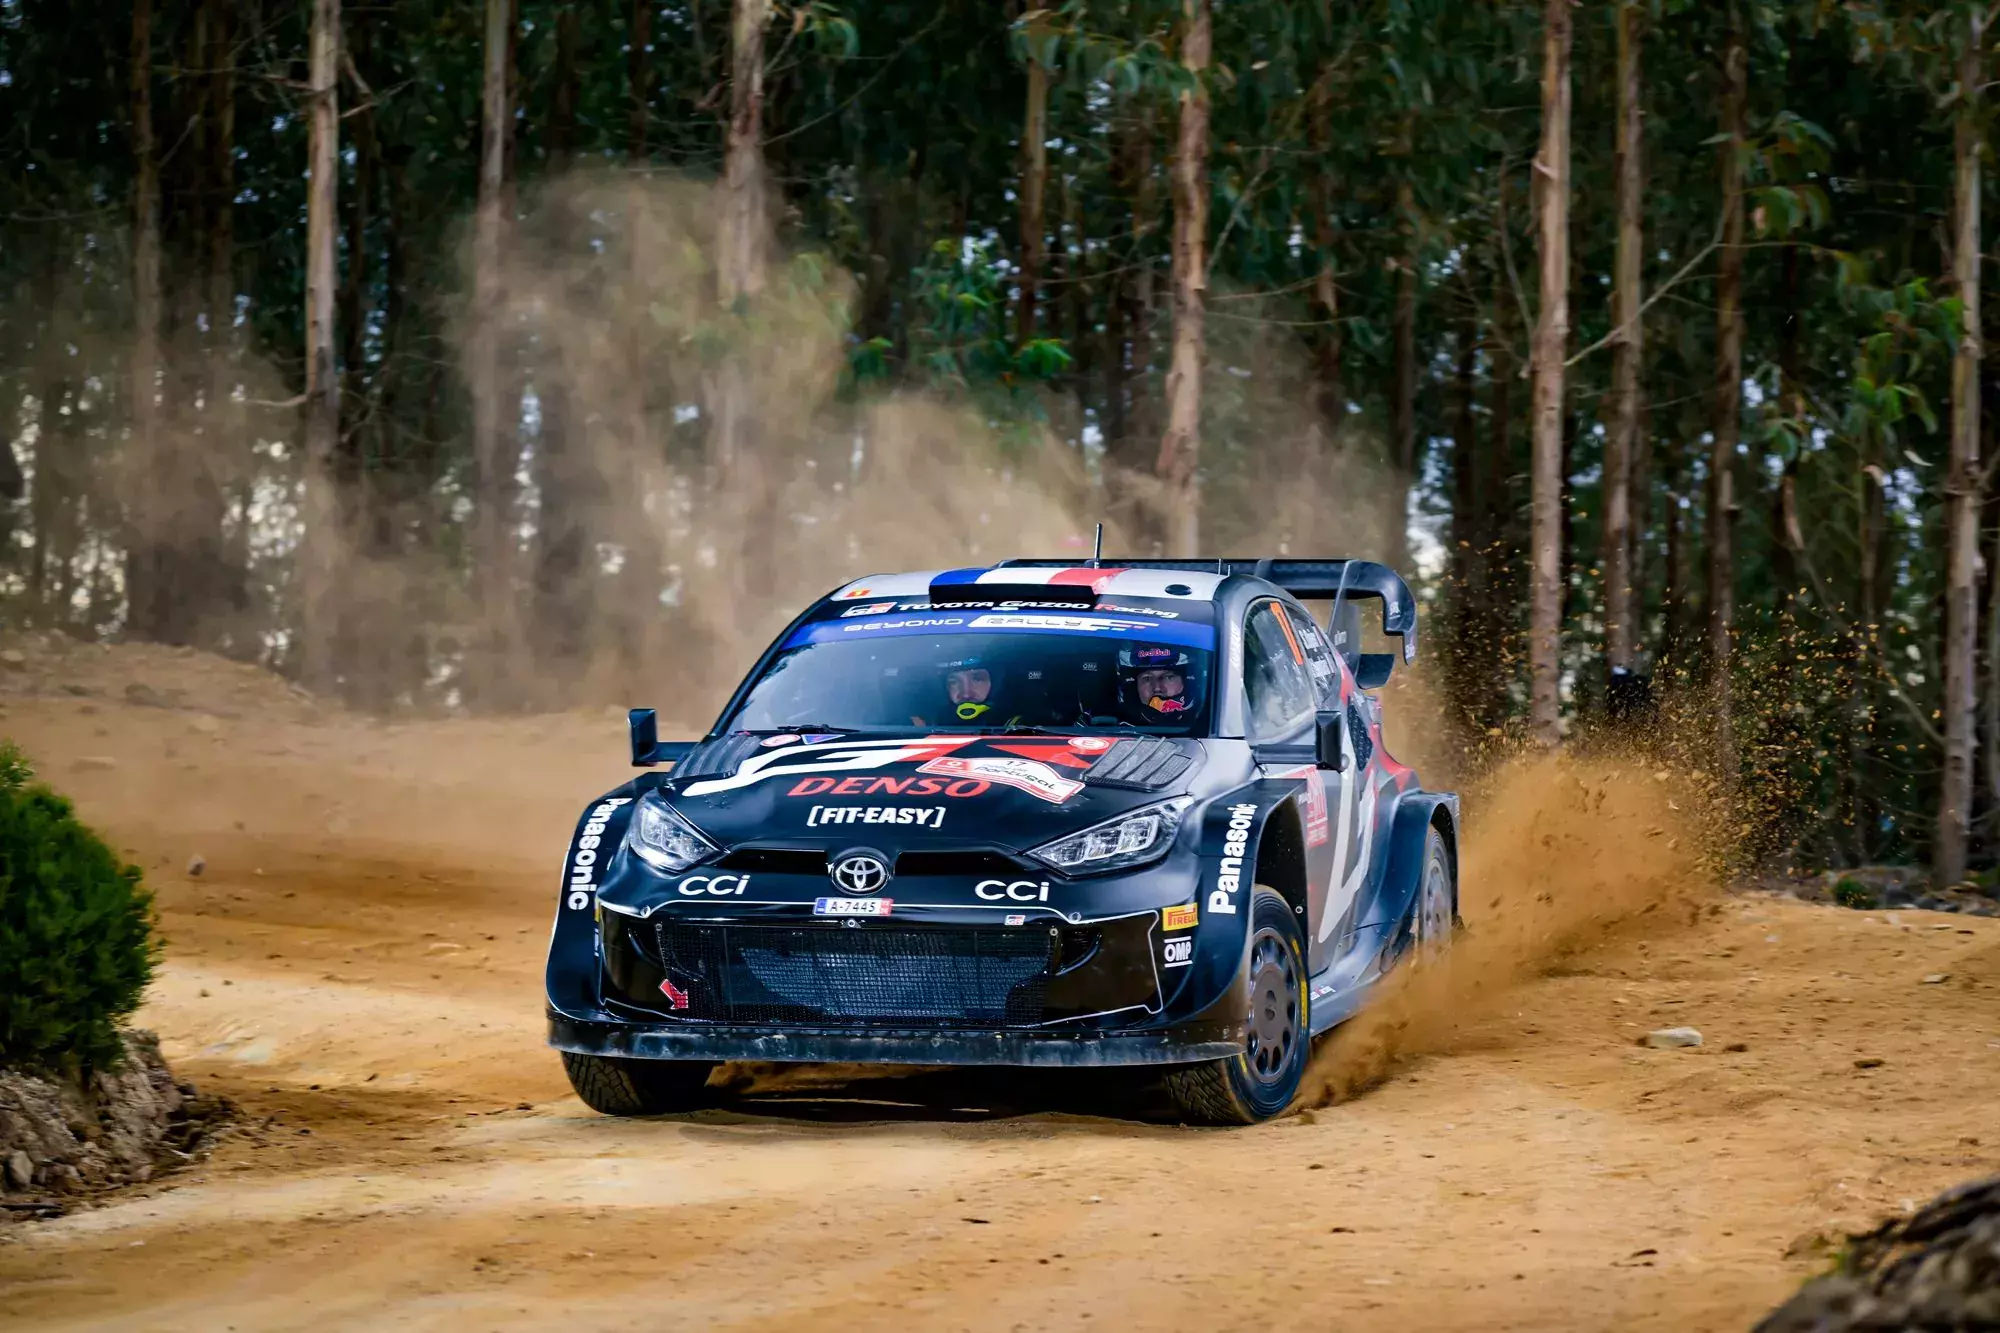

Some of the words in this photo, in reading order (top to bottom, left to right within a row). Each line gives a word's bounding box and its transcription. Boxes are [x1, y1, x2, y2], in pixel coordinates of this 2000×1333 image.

[898, 601, 995, 611] TOYOTA
[999, 600, 1091, 609] GAZOO
[1094, 603, 1179, 618] Racing
[843, 618, 964, 632] BEYOND
[787, 777, 991, 797] DENSO
[806, 805, 947, 828] [FIT-EASY]
[568, 797, 633, 910] Panasonic
[1207, 803, 1258, 914] Panasonic
[829, 901, 876, 913] A-7445
[1164, 940, 1192, 962] OMP
